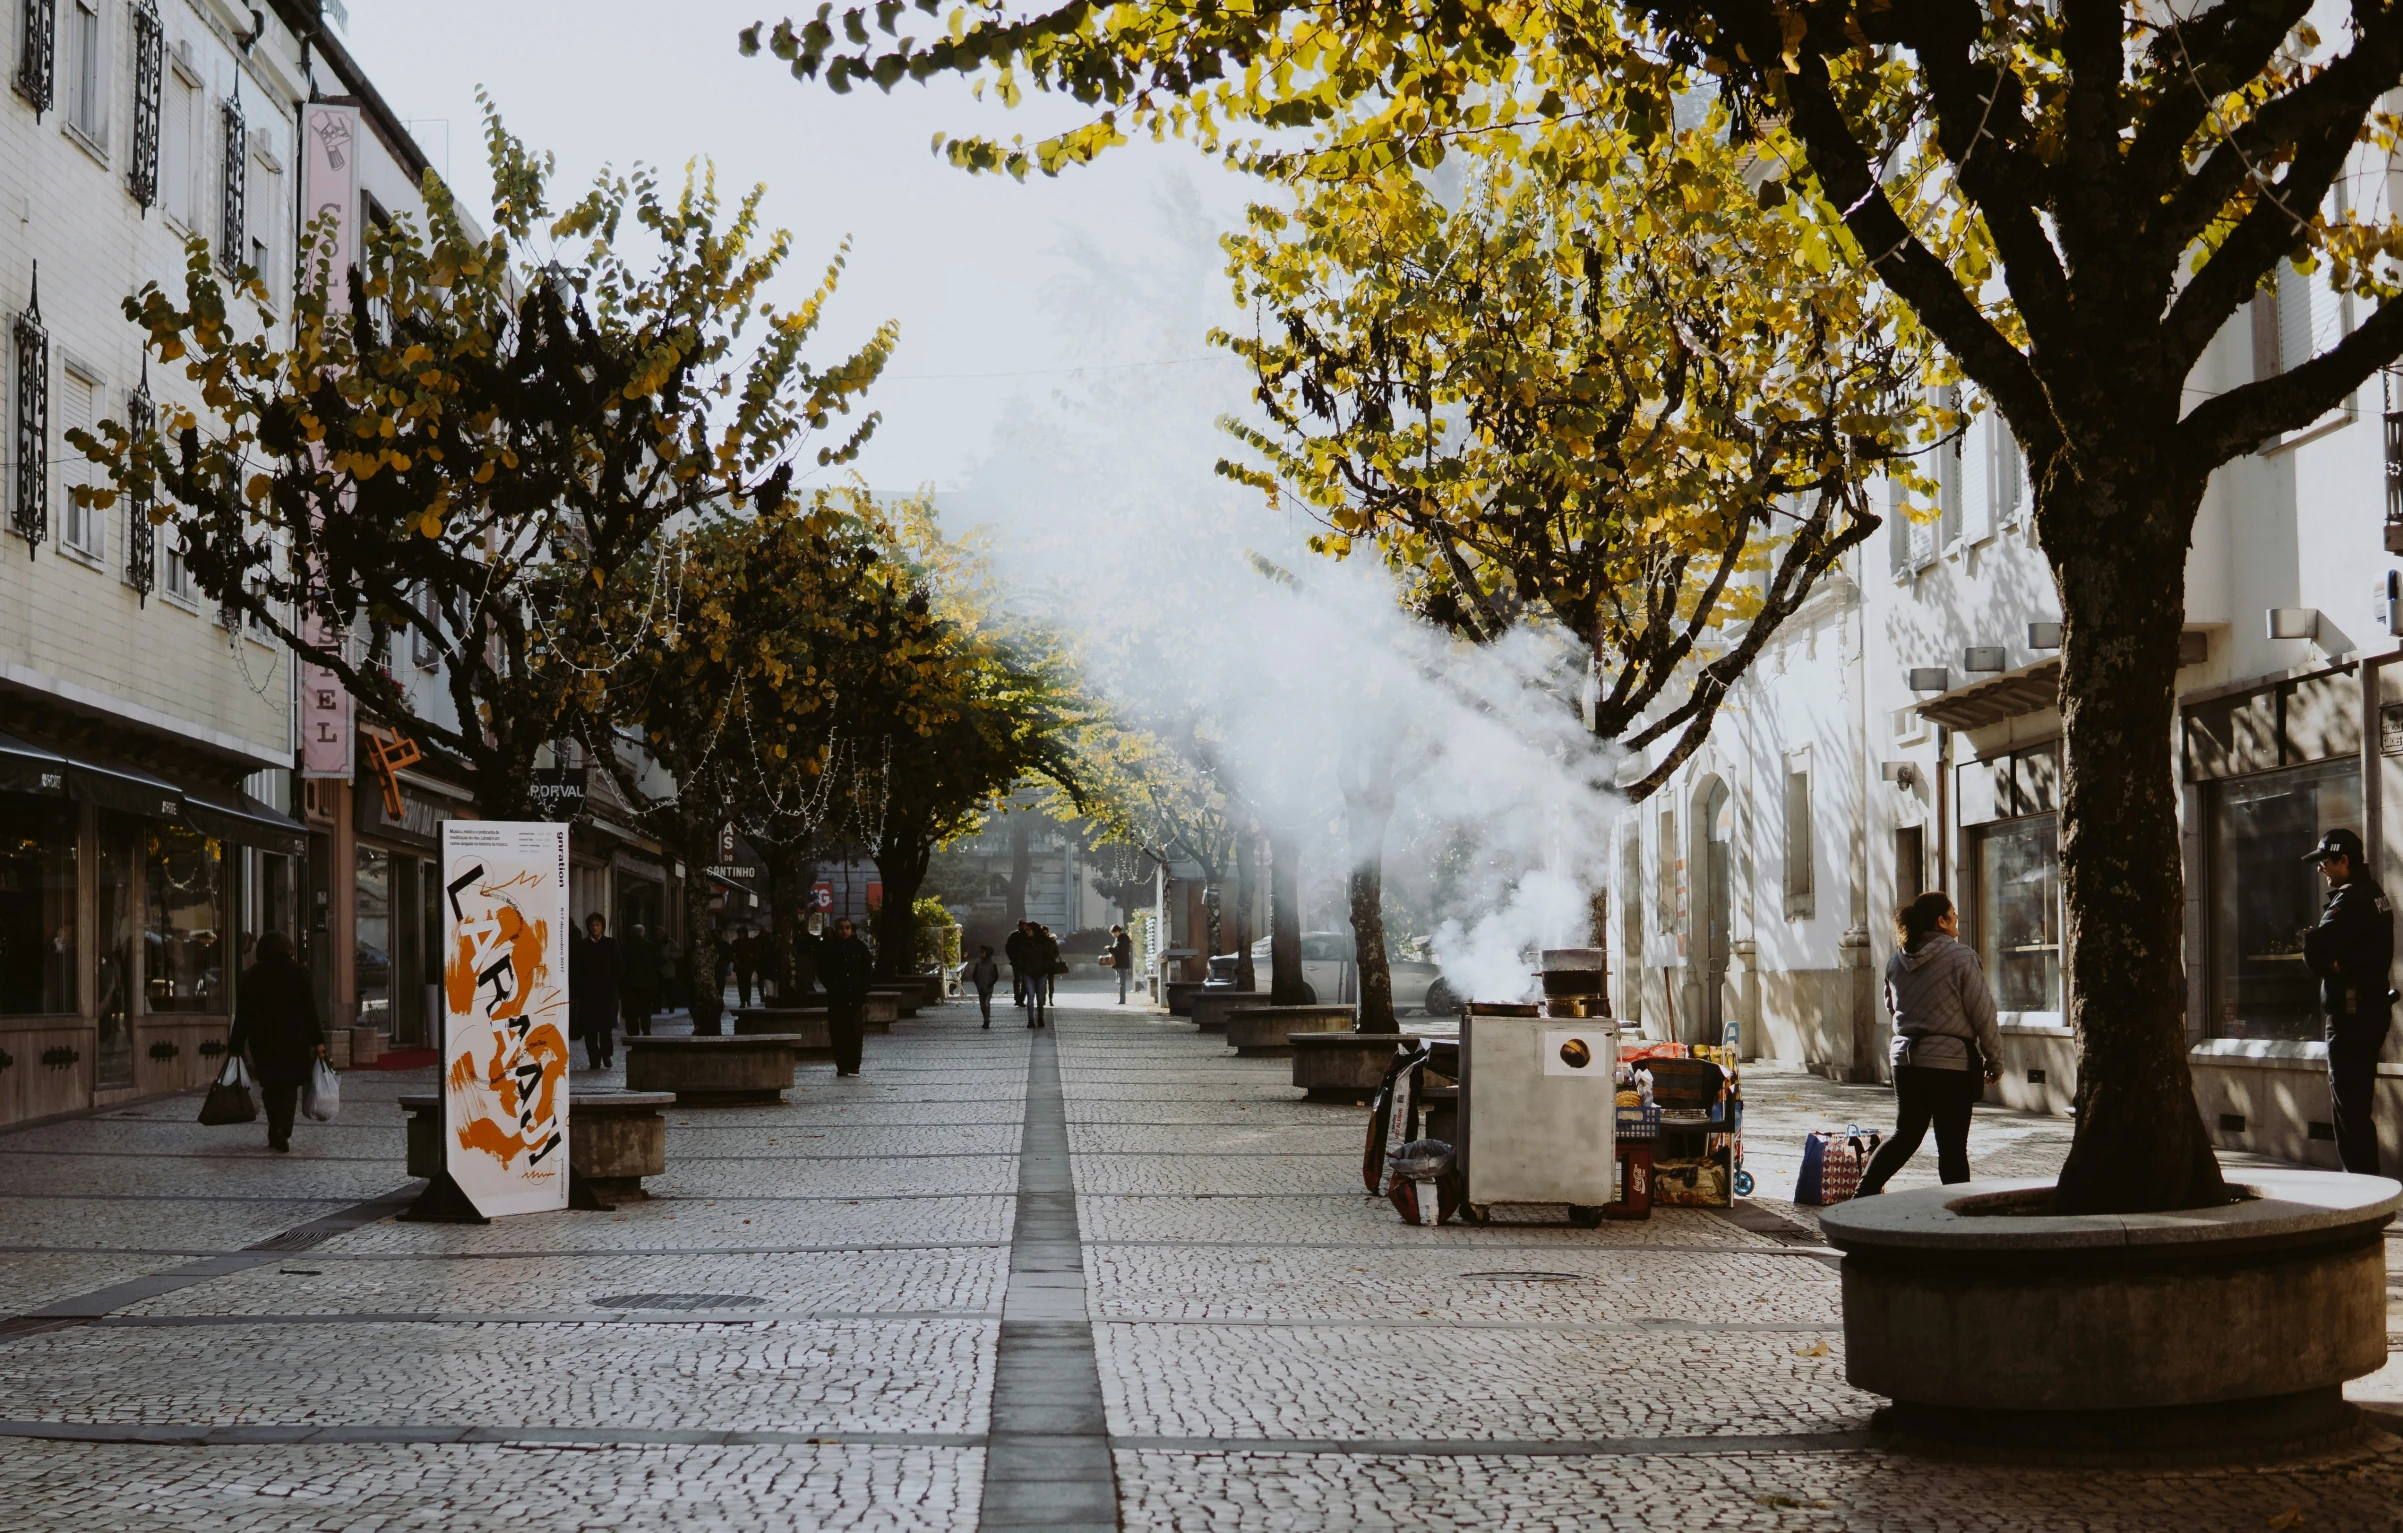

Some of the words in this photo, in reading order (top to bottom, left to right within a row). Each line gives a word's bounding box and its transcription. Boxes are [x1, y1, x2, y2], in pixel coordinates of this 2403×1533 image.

[723, 821, 734, 849] AS
[556, 831, 566, 888] gnration
[1633, 1164, 1642, 1192] Coca-Cola
